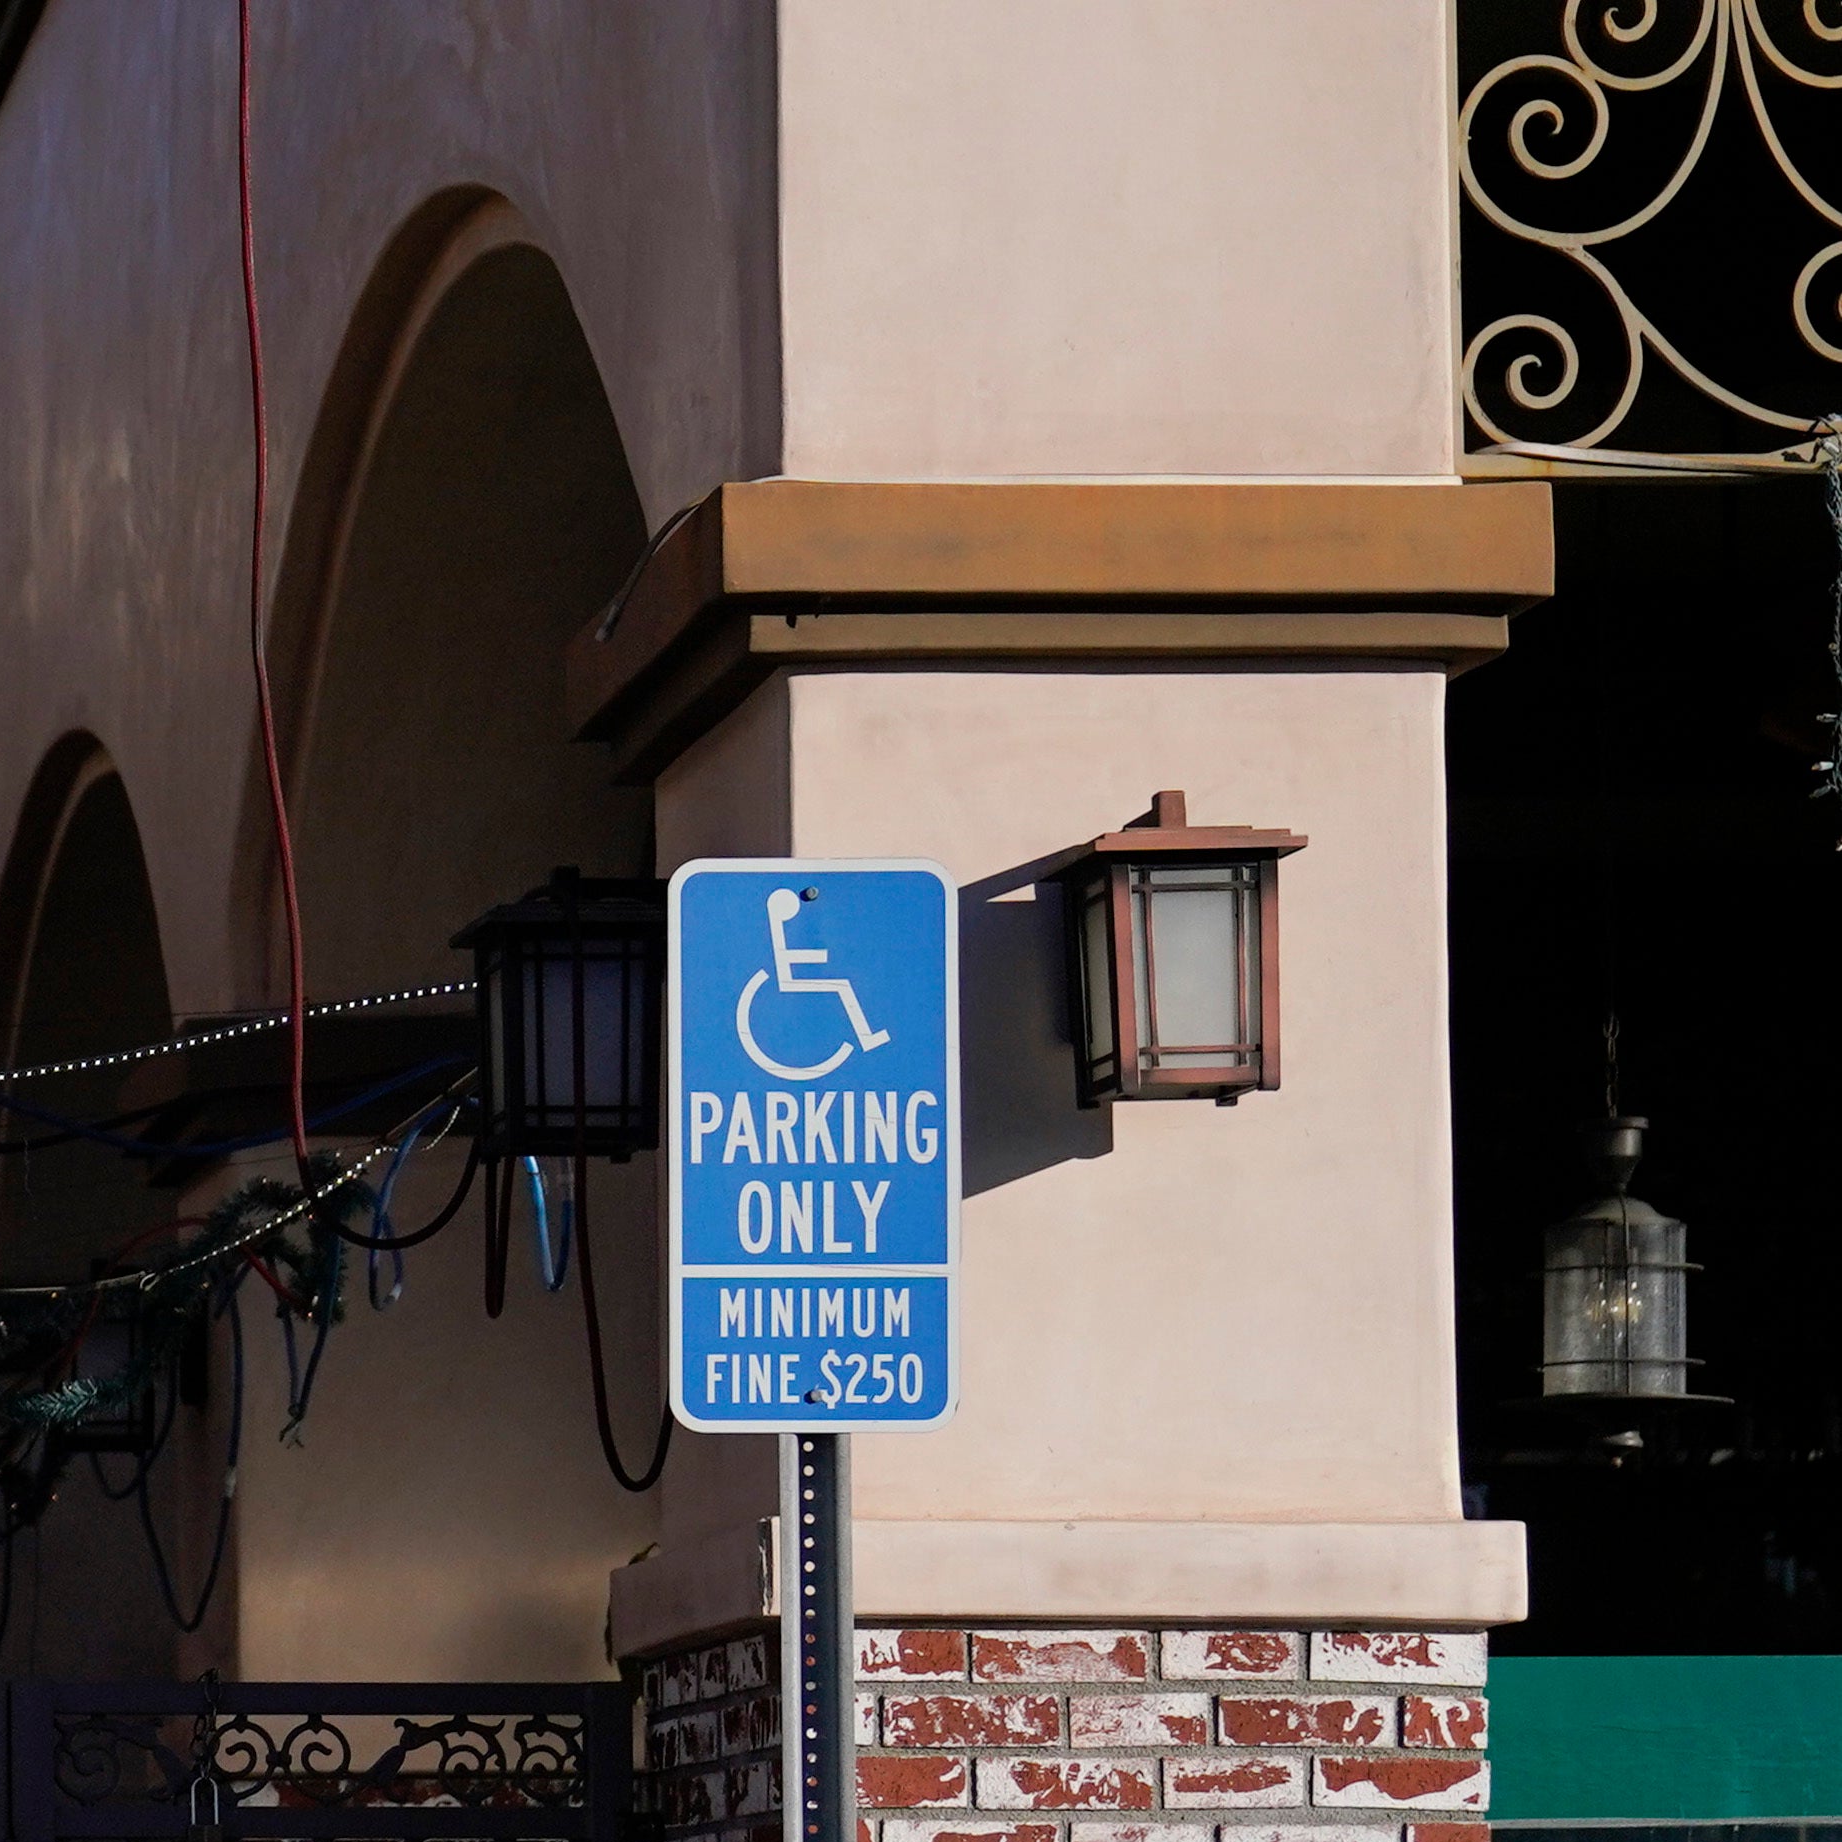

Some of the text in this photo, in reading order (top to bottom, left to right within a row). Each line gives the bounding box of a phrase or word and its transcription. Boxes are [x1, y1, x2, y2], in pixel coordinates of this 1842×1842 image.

[689, 1090, 939, 1165] PARKING
[737, 1180, 891, 1254] ONLY
[719, 1287, 910, 1338] MINIMUM
[706, 1349, 923, 1410] FINE $250
